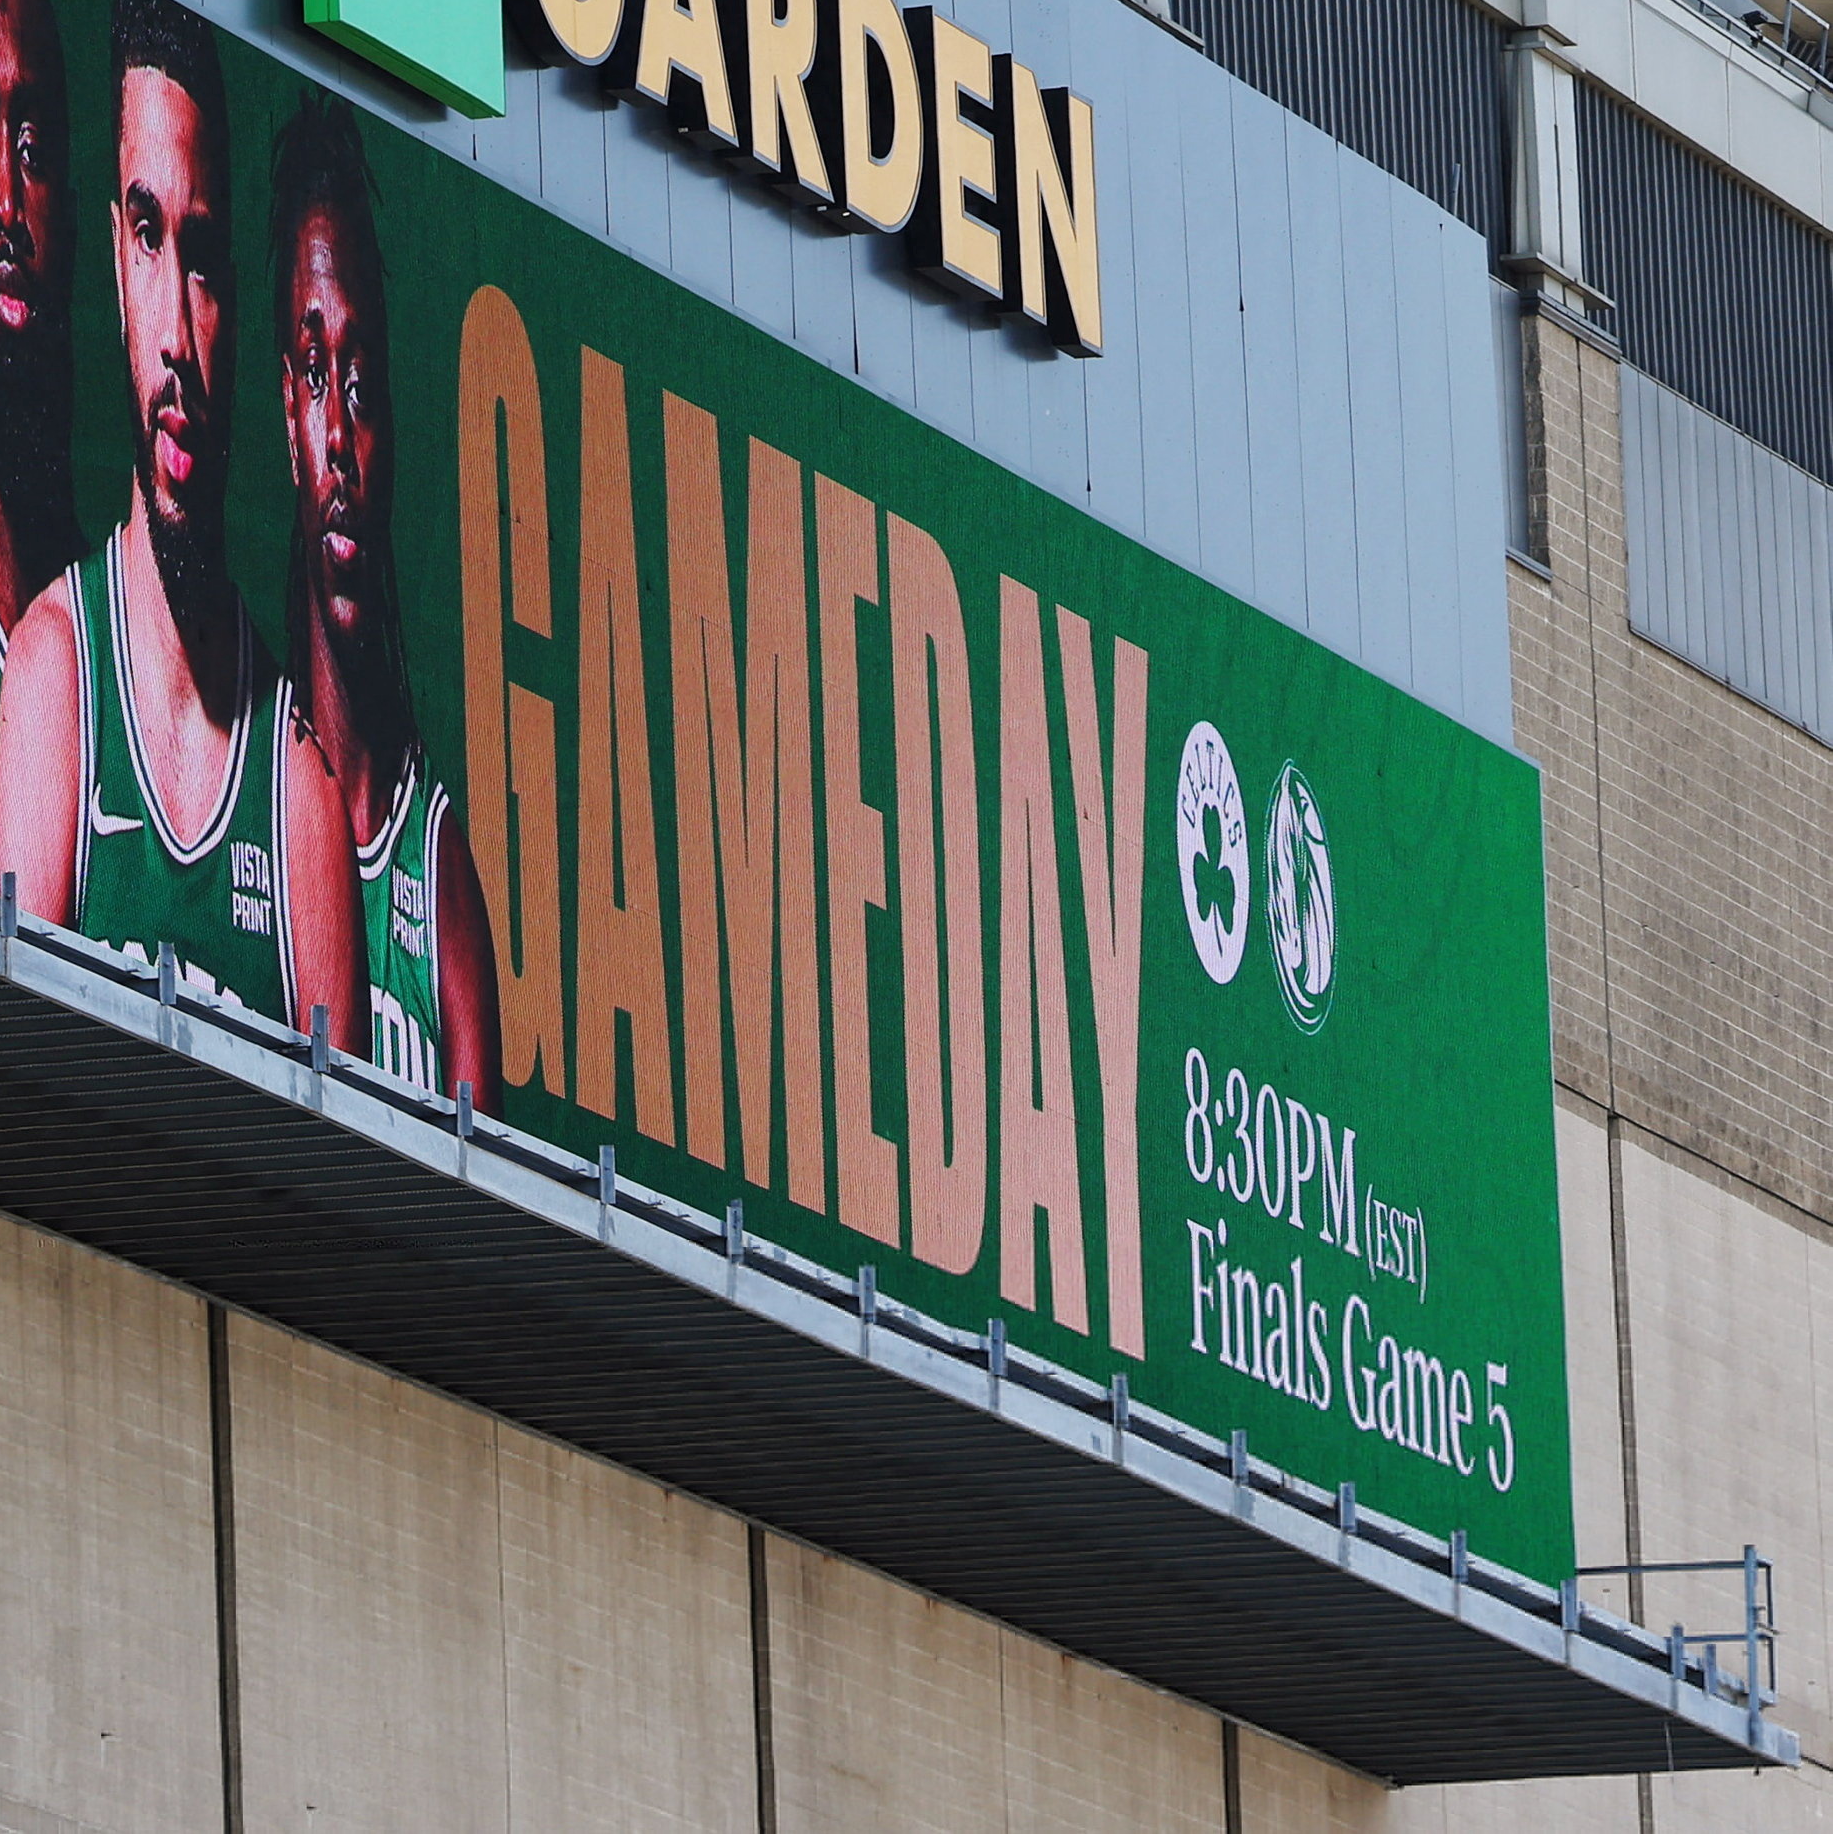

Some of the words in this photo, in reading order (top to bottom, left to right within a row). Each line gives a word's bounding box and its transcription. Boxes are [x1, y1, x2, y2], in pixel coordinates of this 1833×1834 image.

[458, 284, 1149, 1361] GAMEDAY
[1181, 739, 1244, 850] CELTICS
[230, 840, 272, 900] VISTA
[392, 863, 425, 921] VISTA
[232, 890, 272, 937] PRINT
[392, 906, 426, 958] PRINT
[1184, 1047, 1362, 1258] 8:30PM
[1365, 1183, 1428, 1305] (EST)
[1186, 1218, 1332, 1411] Finals
[1341, 1294, 1476, 1476] Game
[1486, 1361, 1515, 1493] 5
